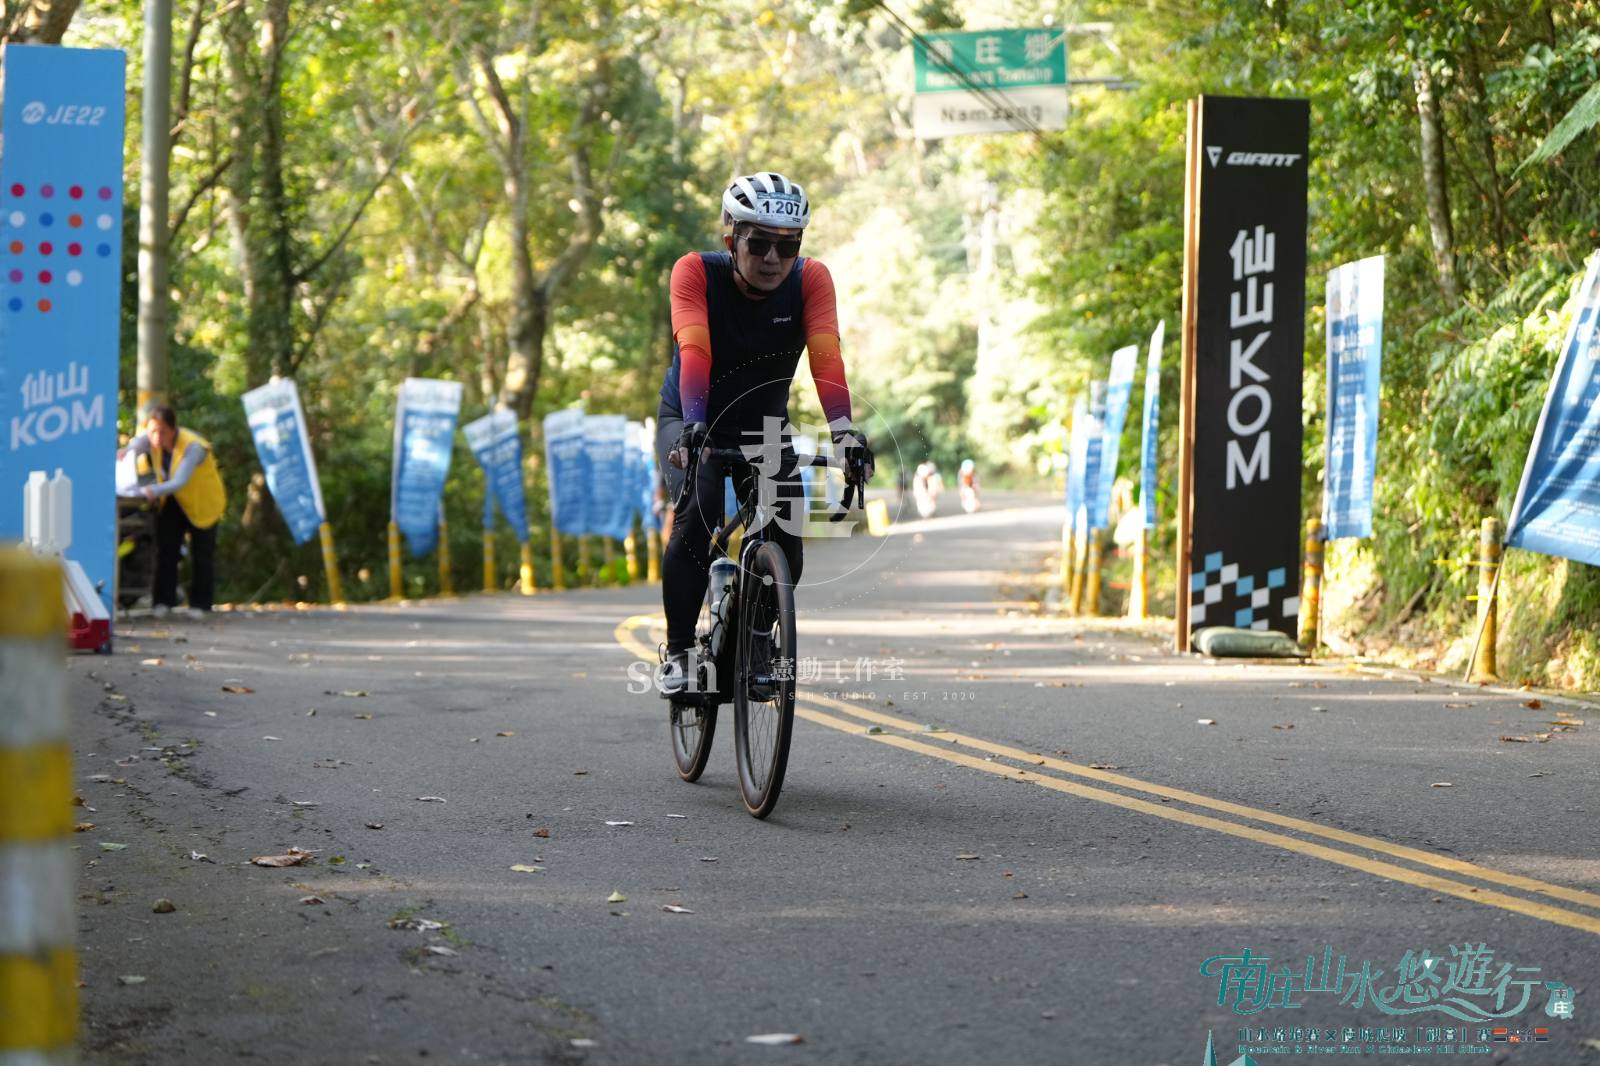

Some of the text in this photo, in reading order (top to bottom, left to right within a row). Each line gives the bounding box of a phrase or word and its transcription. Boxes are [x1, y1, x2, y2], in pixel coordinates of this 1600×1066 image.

[46, 105, 106, 126] JE22
[1226, 151, 1302, 167] GIANT
[20, 361, 88, 411] 仙山
[10, 393, 104, 451] KOM
